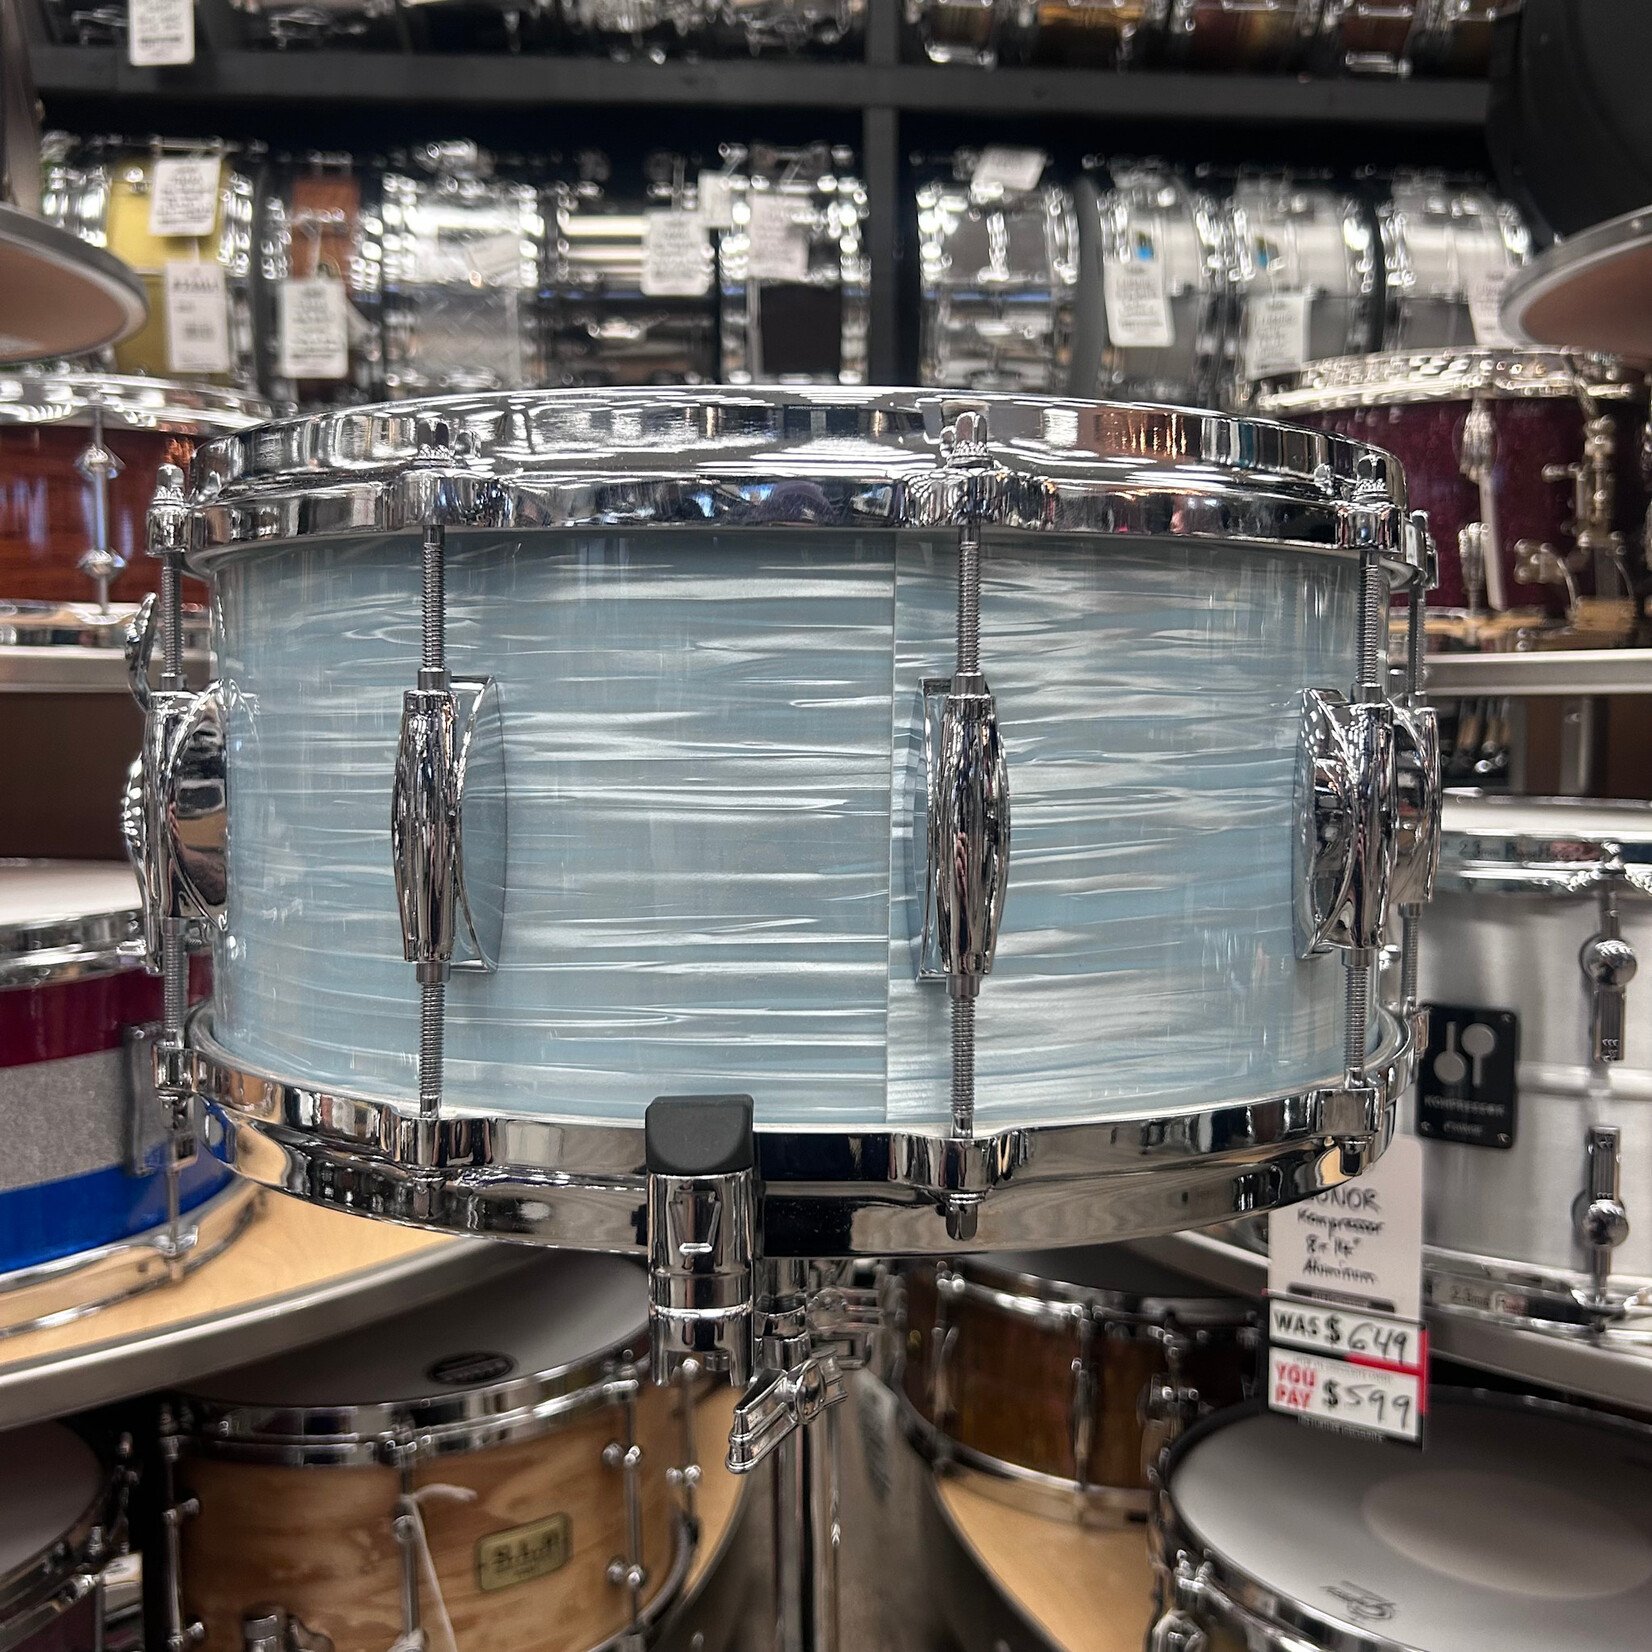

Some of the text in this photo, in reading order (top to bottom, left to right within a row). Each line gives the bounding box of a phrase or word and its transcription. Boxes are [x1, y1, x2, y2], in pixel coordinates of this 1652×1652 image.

[1310, 1187, 1382, 1214] ONOR
[1274, 1310, 1320, 1337] WAS
[1275, 1360, 1317, 1387] YOU
[1322, 1378, 1413, 1431] $599
[1275, 1383, 1313, 1409] PAY
